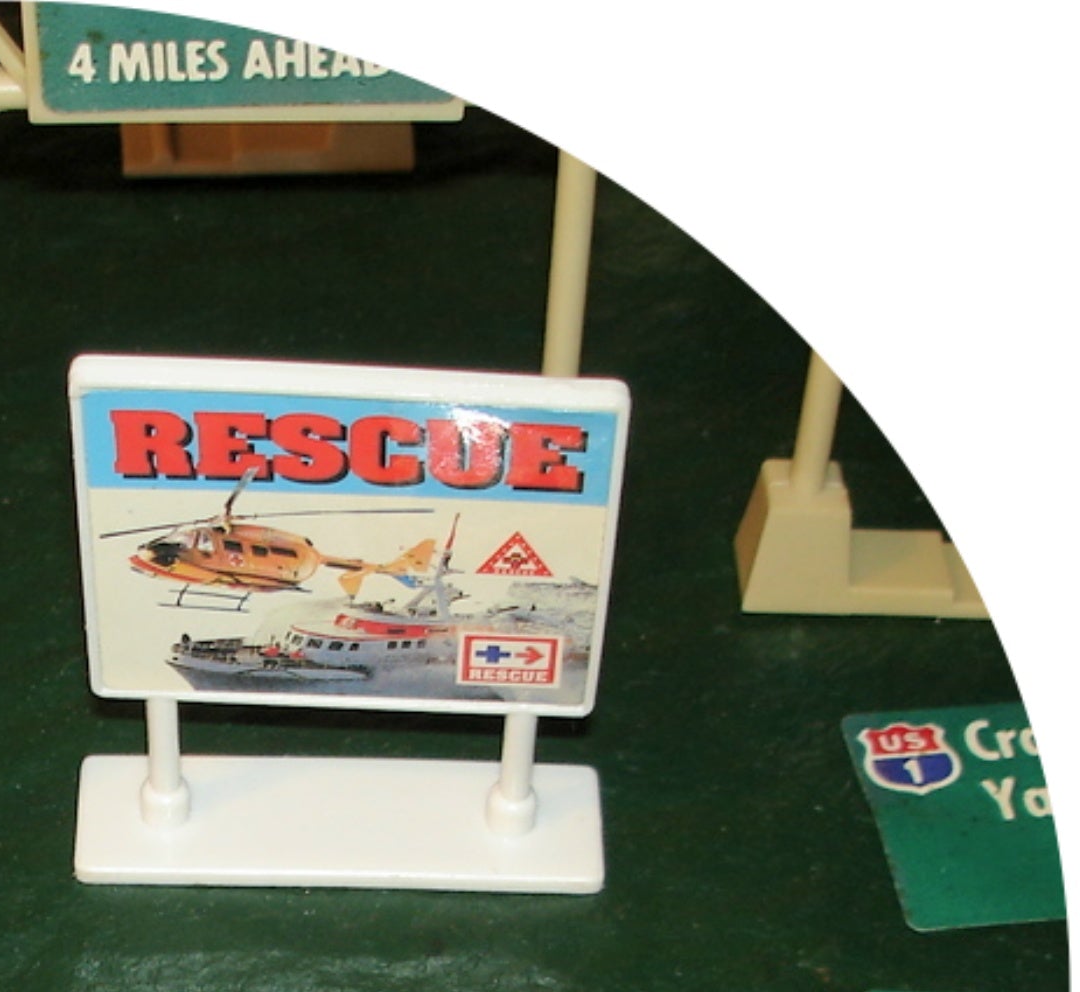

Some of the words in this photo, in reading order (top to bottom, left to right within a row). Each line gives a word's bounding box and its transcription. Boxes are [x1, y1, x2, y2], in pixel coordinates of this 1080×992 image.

[68, 43, 97, 83] 4
[110, 40, 228, 83] MILES
[110, 410, 587, 493] RESCUE
[469, 668, 549, 683] RESCUE
[878, 732, 928, 751] US
[904, 760, 924, 784] 1
